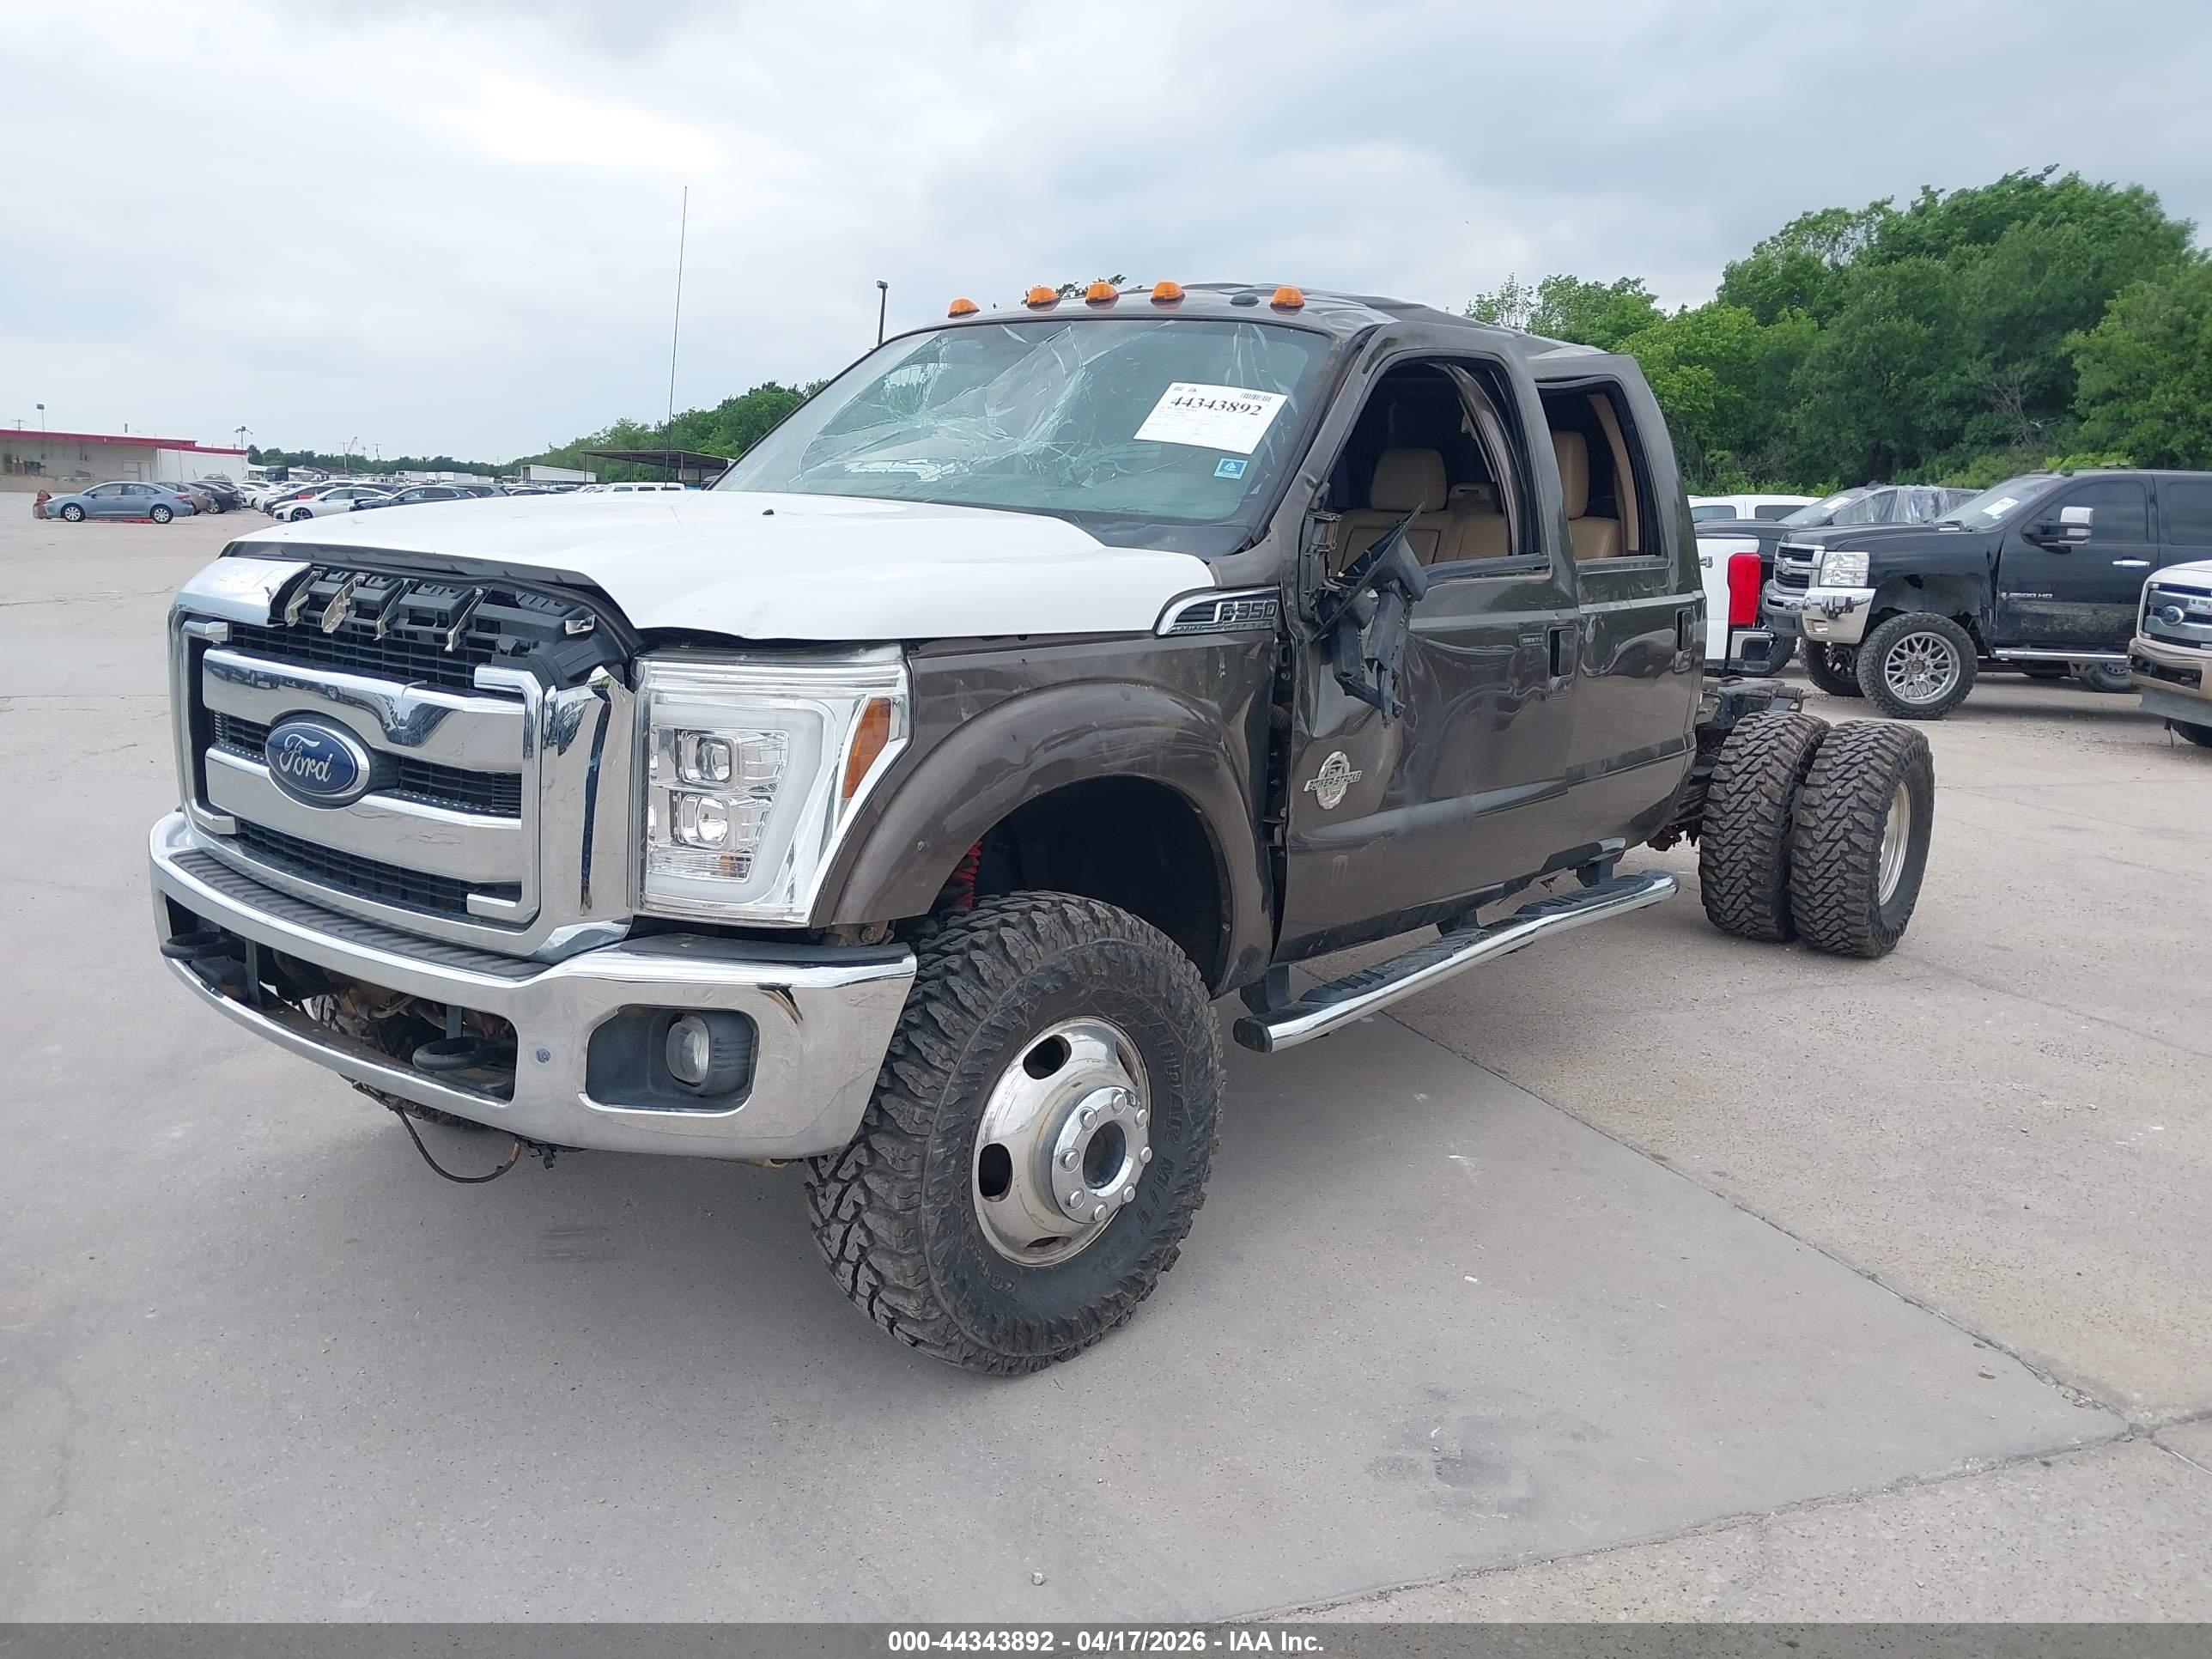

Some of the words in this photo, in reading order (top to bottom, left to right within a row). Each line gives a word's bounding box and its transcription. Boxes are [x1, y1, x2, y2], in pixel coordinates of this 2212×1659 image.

[1170, 396, 1262, 416] 44343892
[277, 733, 334, 783] Ford
[1307, 776, 1334, 791] POWER
[1334, 771, 1363, 786] STROKE
[1137, 1155, 1176, 1234] M/T
